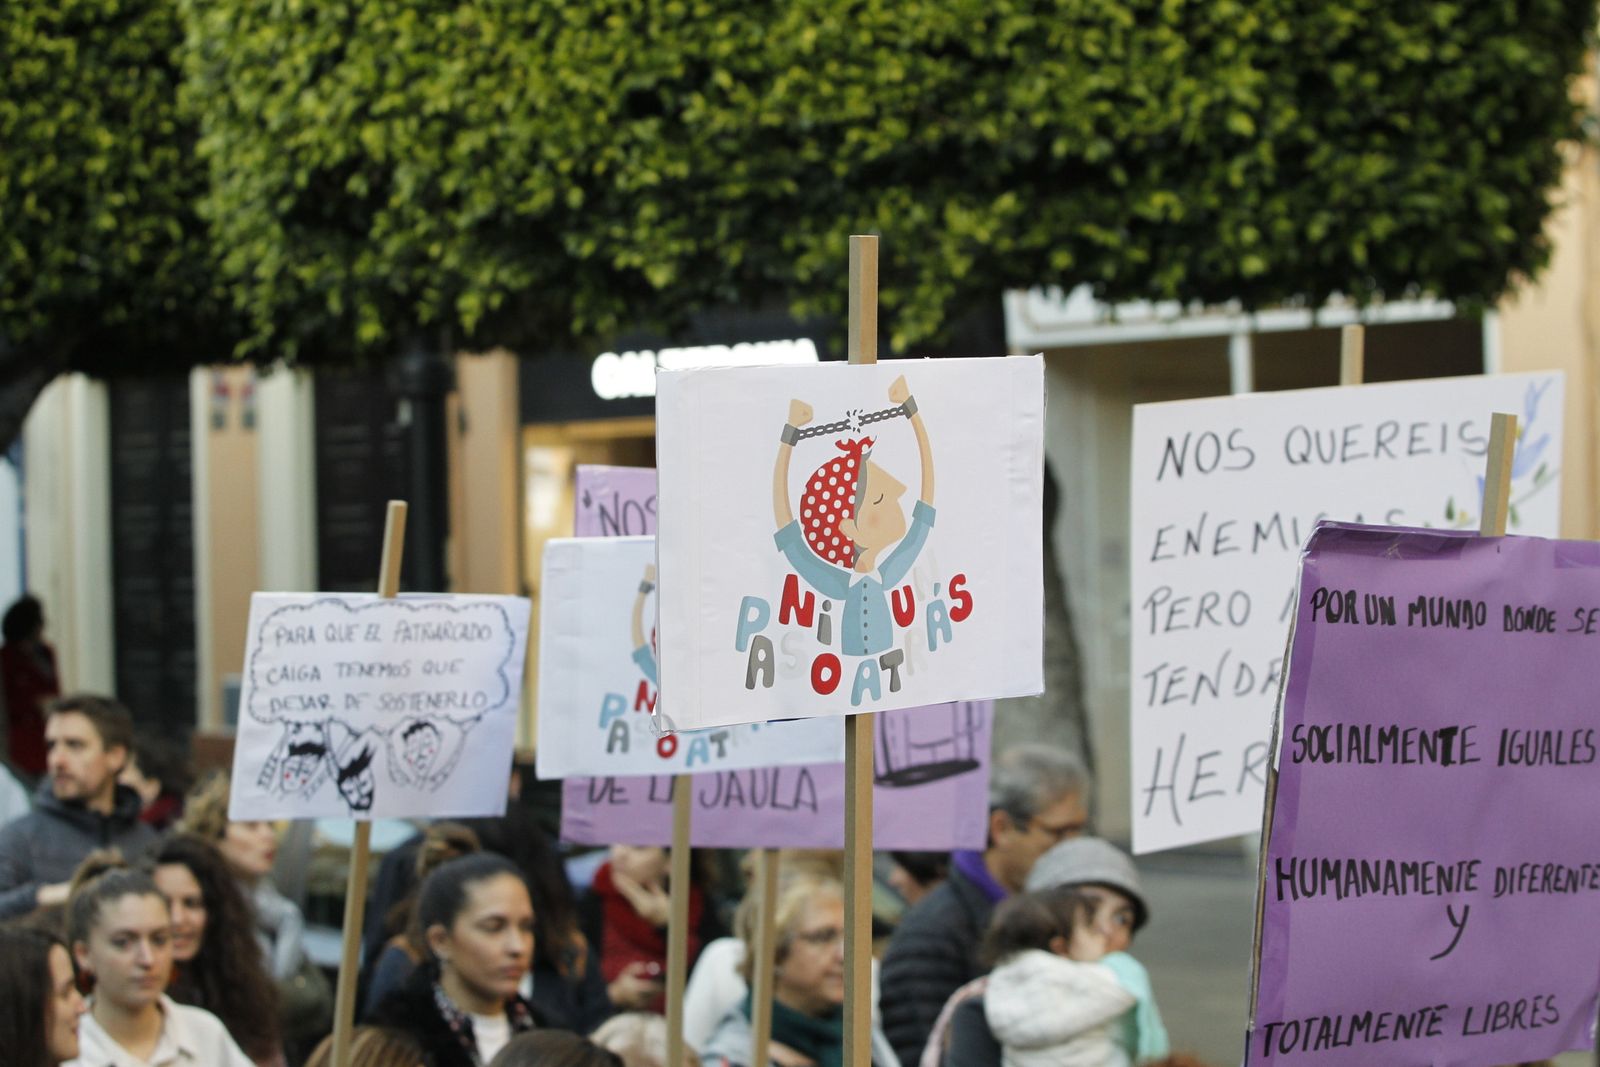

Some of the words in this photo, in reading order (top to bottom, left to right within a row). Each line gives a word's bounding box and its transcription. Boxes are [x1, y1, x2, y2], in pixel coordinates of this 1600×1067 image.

[1157, 428, 1256, 481] NOS
[1284, 420, 1488, 467] QUEREIS
[1151, 509, 1404, 562] ENEMI
[1142, 585, 1251, 635] PERO
[1310, 587, 1359, 625] POR
[1365, 594, 1396, 626] UN
[1408, 595, 1487, 630] MUNDO
[1503, 604, 1556, 633] DONDE
[1567, 606, 1600, 635] SE
[275, 624, 316, 648] PARA
[325, 622, 359, 643] QUE
[363, 622, 382, 643] EL
[394, 619, 492, 643] PATRIARCADO
[266, 663, 321, 685] CAIGA
[334, 659, 411, 678] TENEMOS
[421, 658, 464, 676] QUE
[270, 692, 334, 714] DEJAR
[344, 691, 371, 710] DE
[376, 690, 488, 712] SOSTENERLO
[1292, 722, 1481, 767] SOCIALMENTE
[1497, 727, 1596, 767] IGUALES
[588, 776, 630, 804] DE
[699, 767, 818, 813] JAULA
[1275, 857, 1482, 901] HUMANAMENTE
[1263, 1004, 1449, 1057] TOTALMENTE
[1462, 994, 1560, 1037] LIBRES
